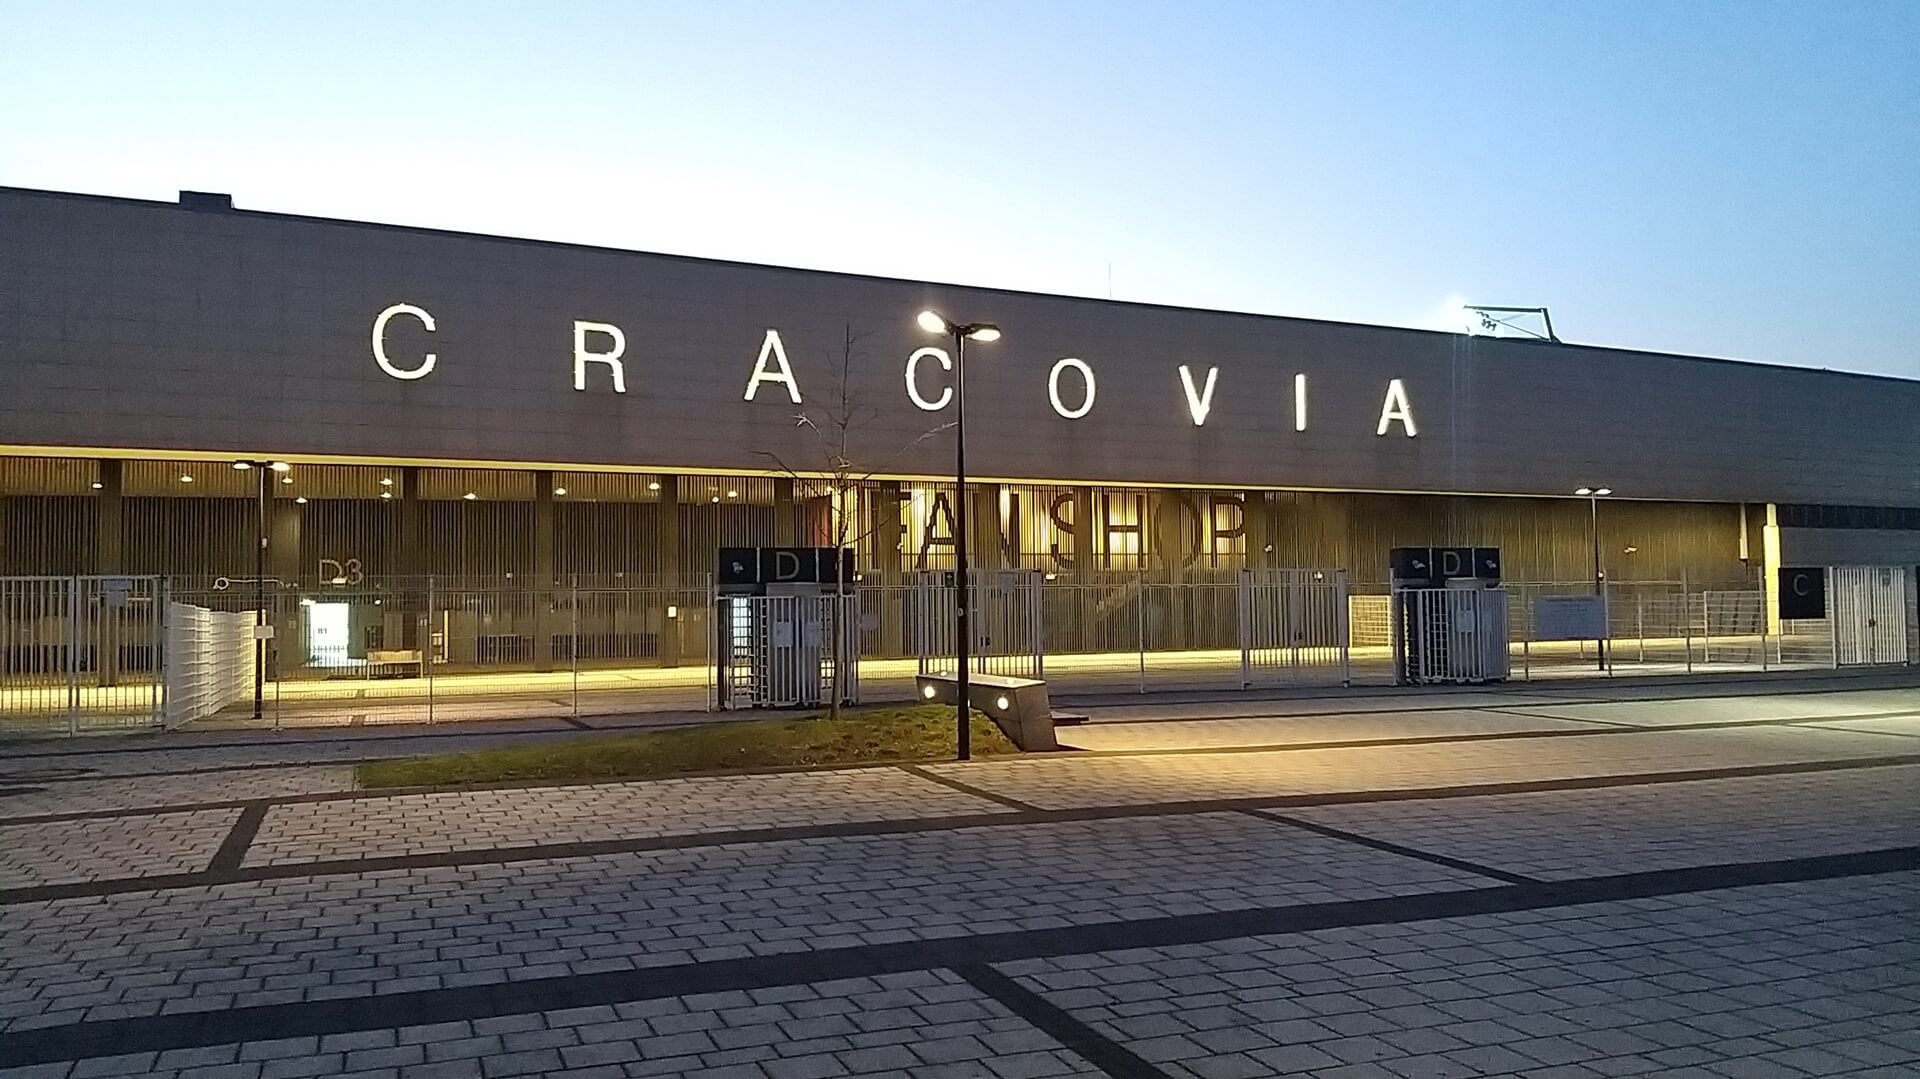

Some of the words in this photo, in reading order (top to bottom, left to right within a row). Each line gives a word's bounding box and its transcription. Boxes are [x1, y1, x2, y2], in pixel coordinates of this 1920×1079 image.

[371, 302, 1417, 437] CRACOVIA
[320, 559, 363, 585] D3
[776, 551, 799, 580] D
[1443, 551, 1460, 575] D
[1794, 574, 1809, 596] C
